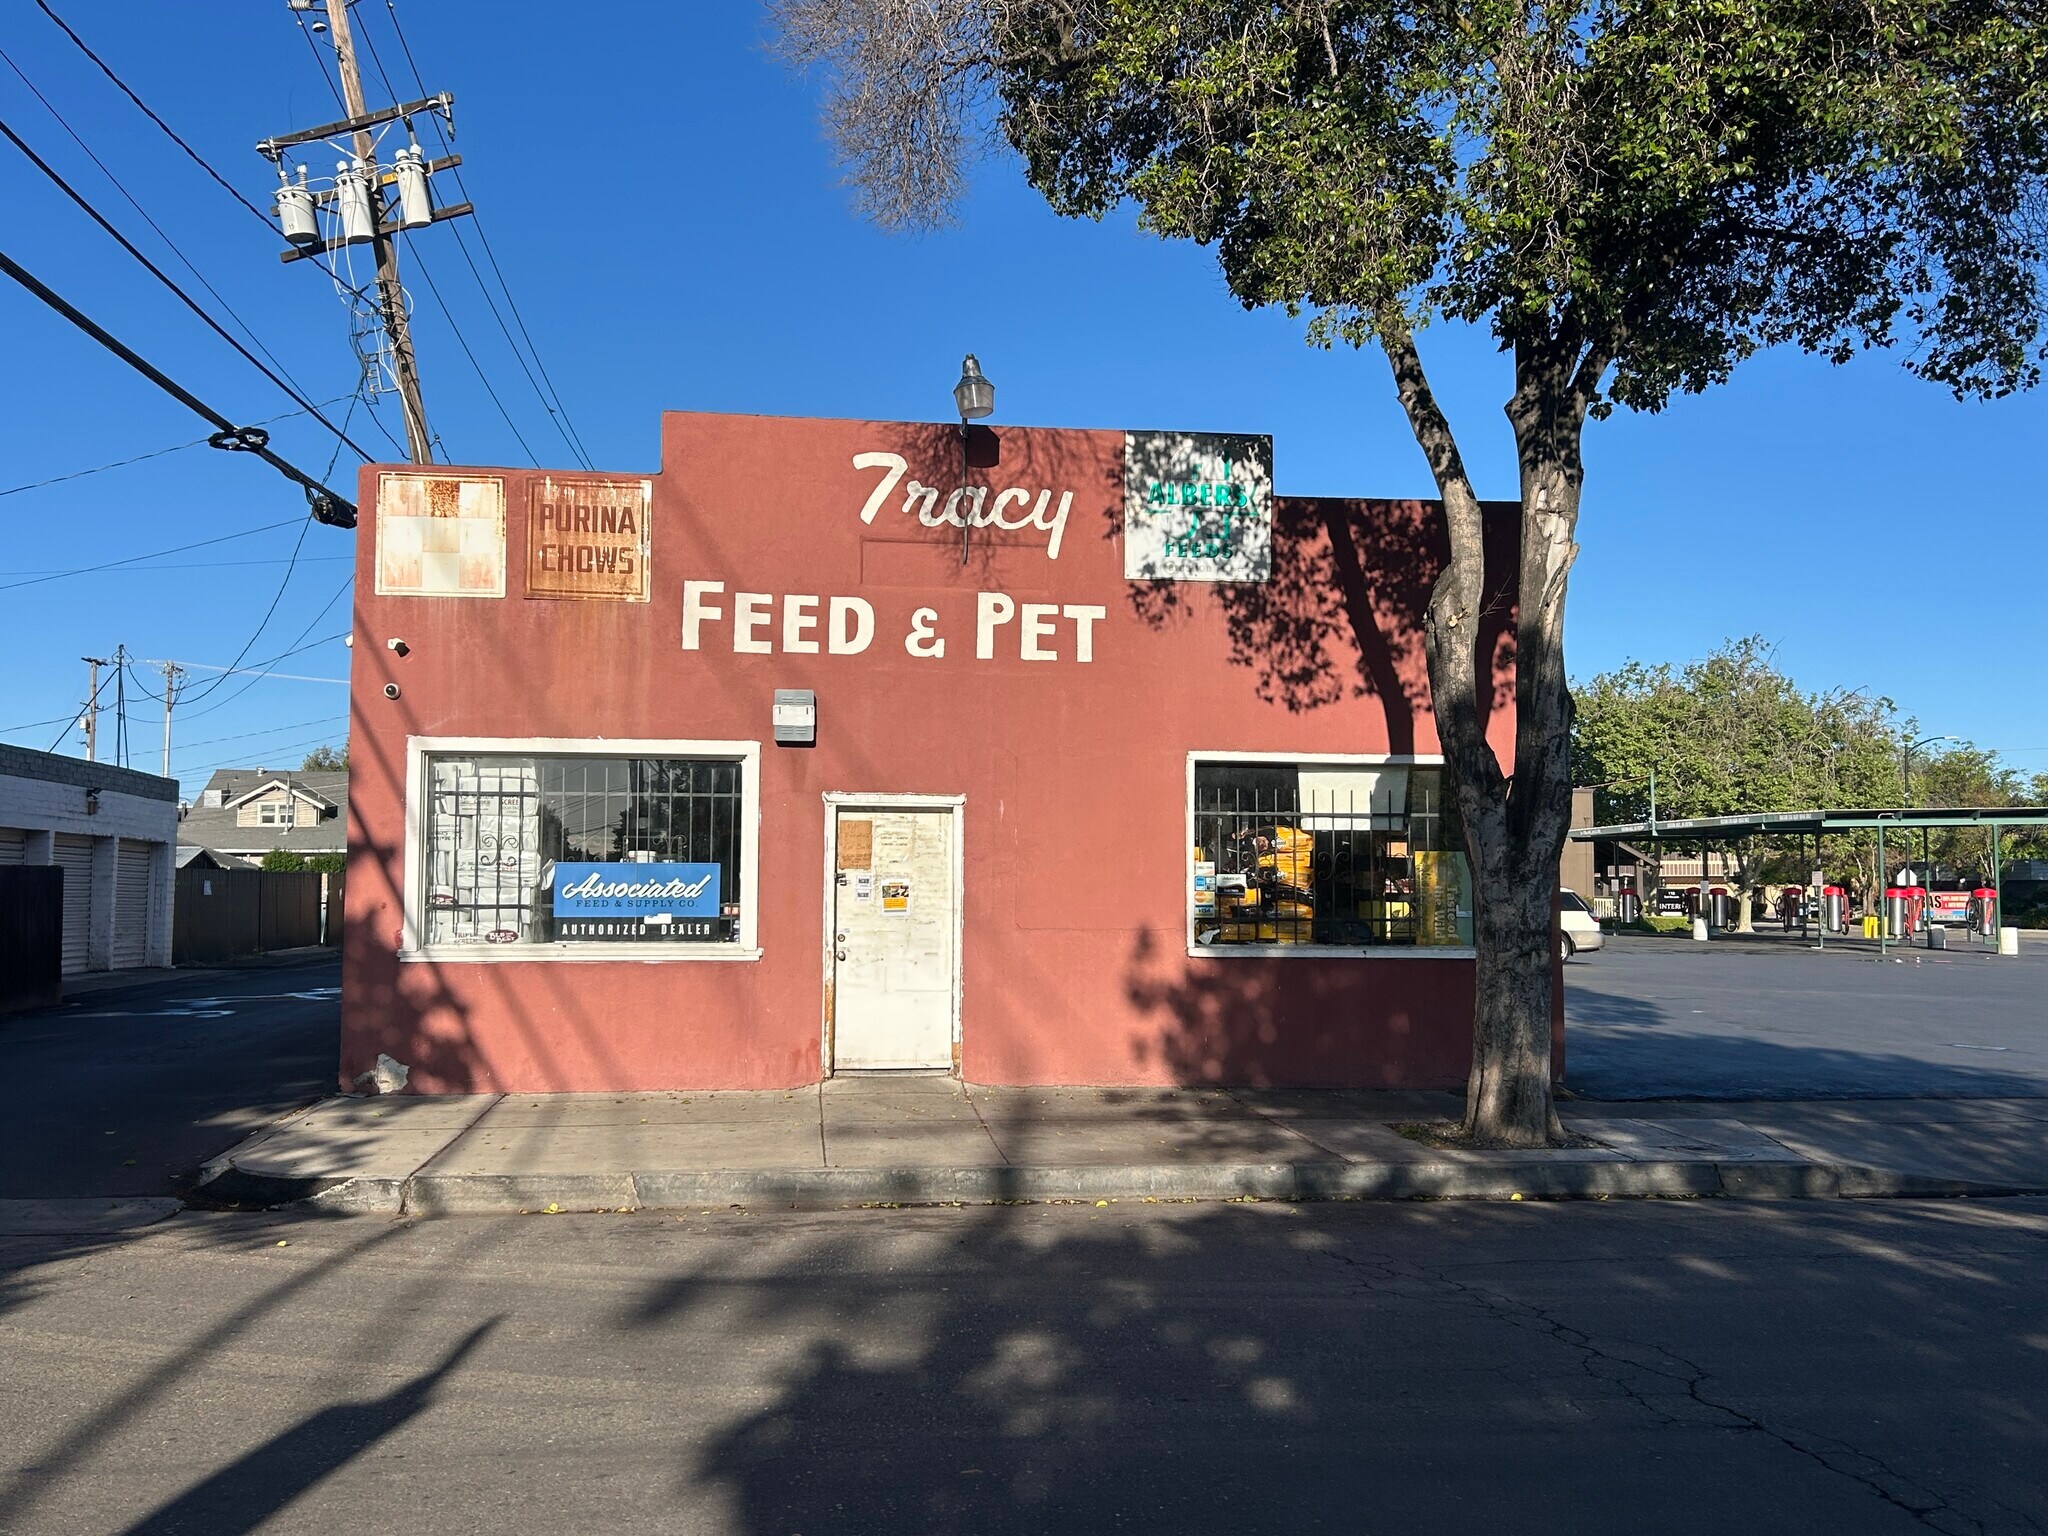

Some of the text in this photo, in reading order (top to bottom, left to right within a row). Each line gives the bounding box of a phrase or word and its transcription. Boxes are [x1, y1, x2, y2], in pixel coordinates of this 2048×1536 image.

[853, 452, 1074, 560] Tracy
[1146, 481, 1248, 508] ALBERS
[539, 502, 637, 536] PURINA
[540, 542, 635, 576] CHOWS
[1163, 542, 1234, 559] FEEDS
[681, 579, 1107, 664] FEED & PET
[562, 871, 712, 899] Associated
[576, 899, 699, 908] FEED & SUPPLY CO.
[1446, 886, 1459, 939] Taste of
[561, 923, 710, 936] AUTHORIZED DEALER
[1434, 910, 1446, 939] Wild
